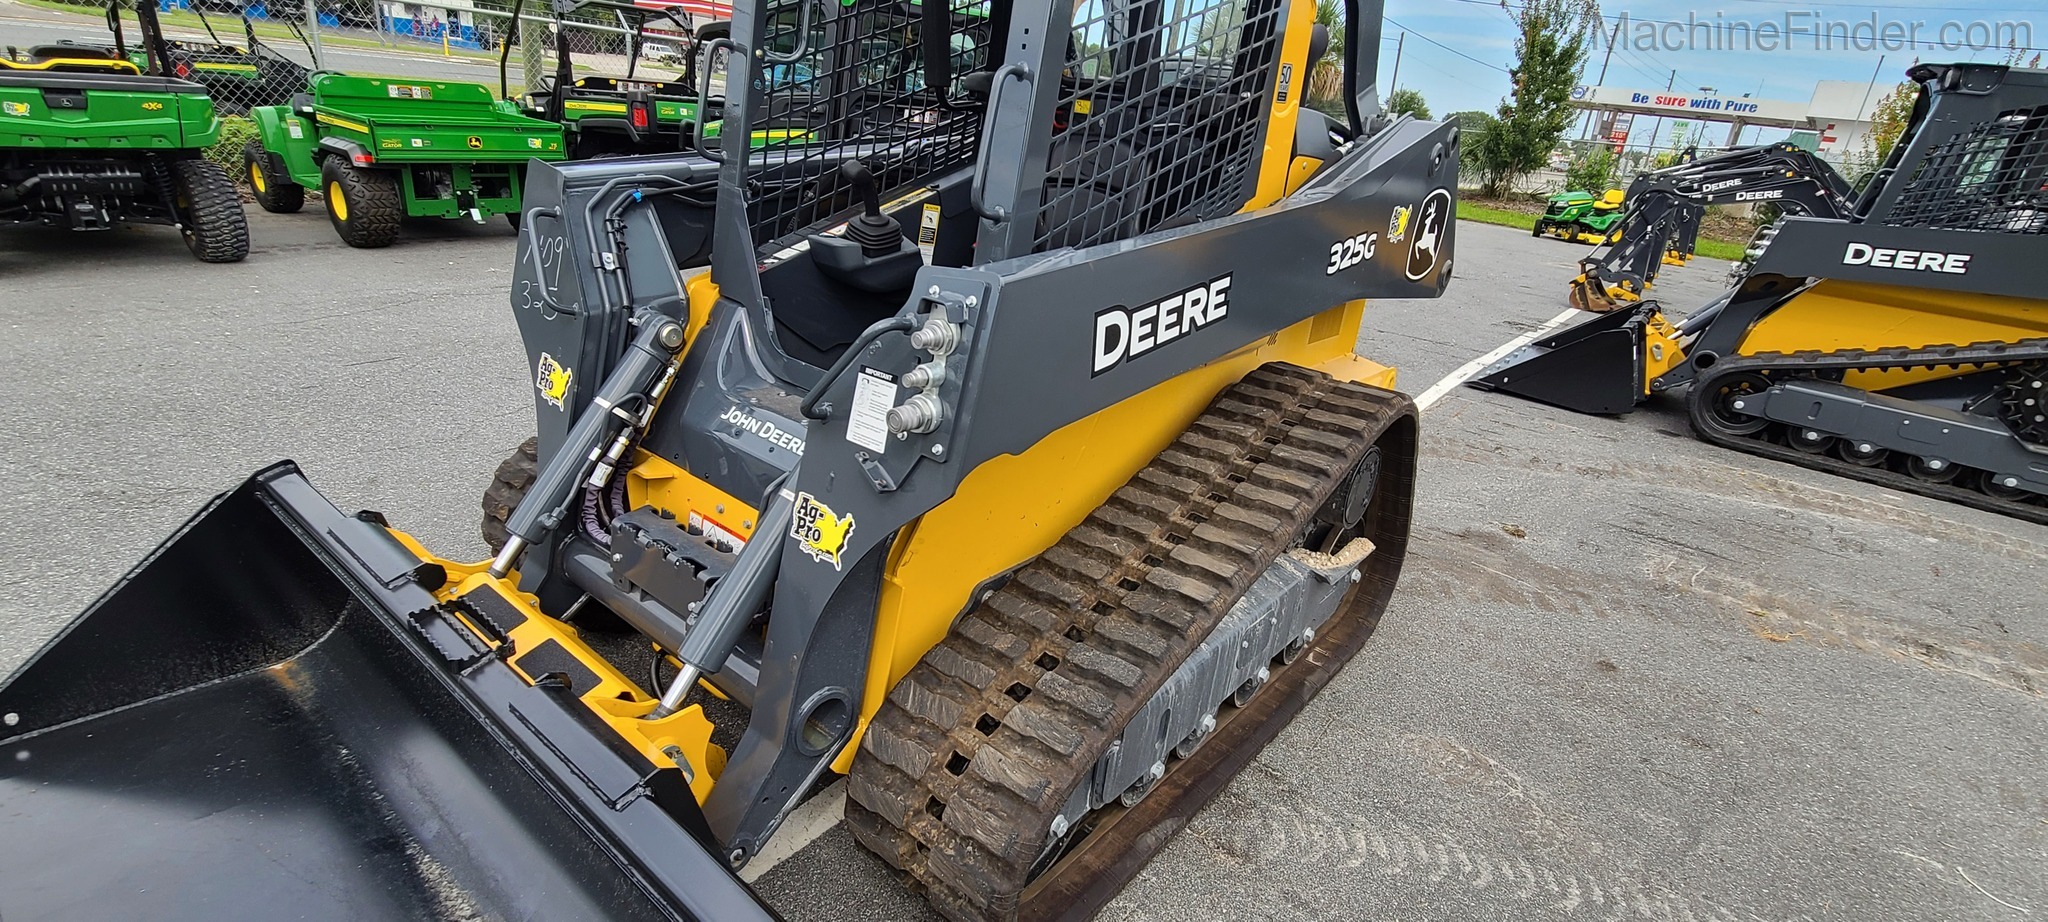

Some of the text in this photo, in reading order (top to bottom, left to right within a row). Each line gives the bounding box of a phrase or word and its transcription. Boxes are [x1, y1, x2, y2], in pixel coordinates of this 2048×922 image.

[1280, 66, 1292, 85] 50
[1631, 92, 1759, 113] Be sure with Pure
[1702, 178, 1743, 193] DEERE
[1735, 190, 1783, 201] DEERE
[1326, 232, 1378, 275] 325G
[1842, 242, 1971, 274] DEERE
[1093, 275, 1232, 373] DEERE
[539, 370, 554, 390] Pro
[864, 367, 894, 382] IMPORTANT
[720, 405, 762, 434] JOHN
[797, 496, 825, 524] Ag-
[794, 516, 821, 542] Pro
